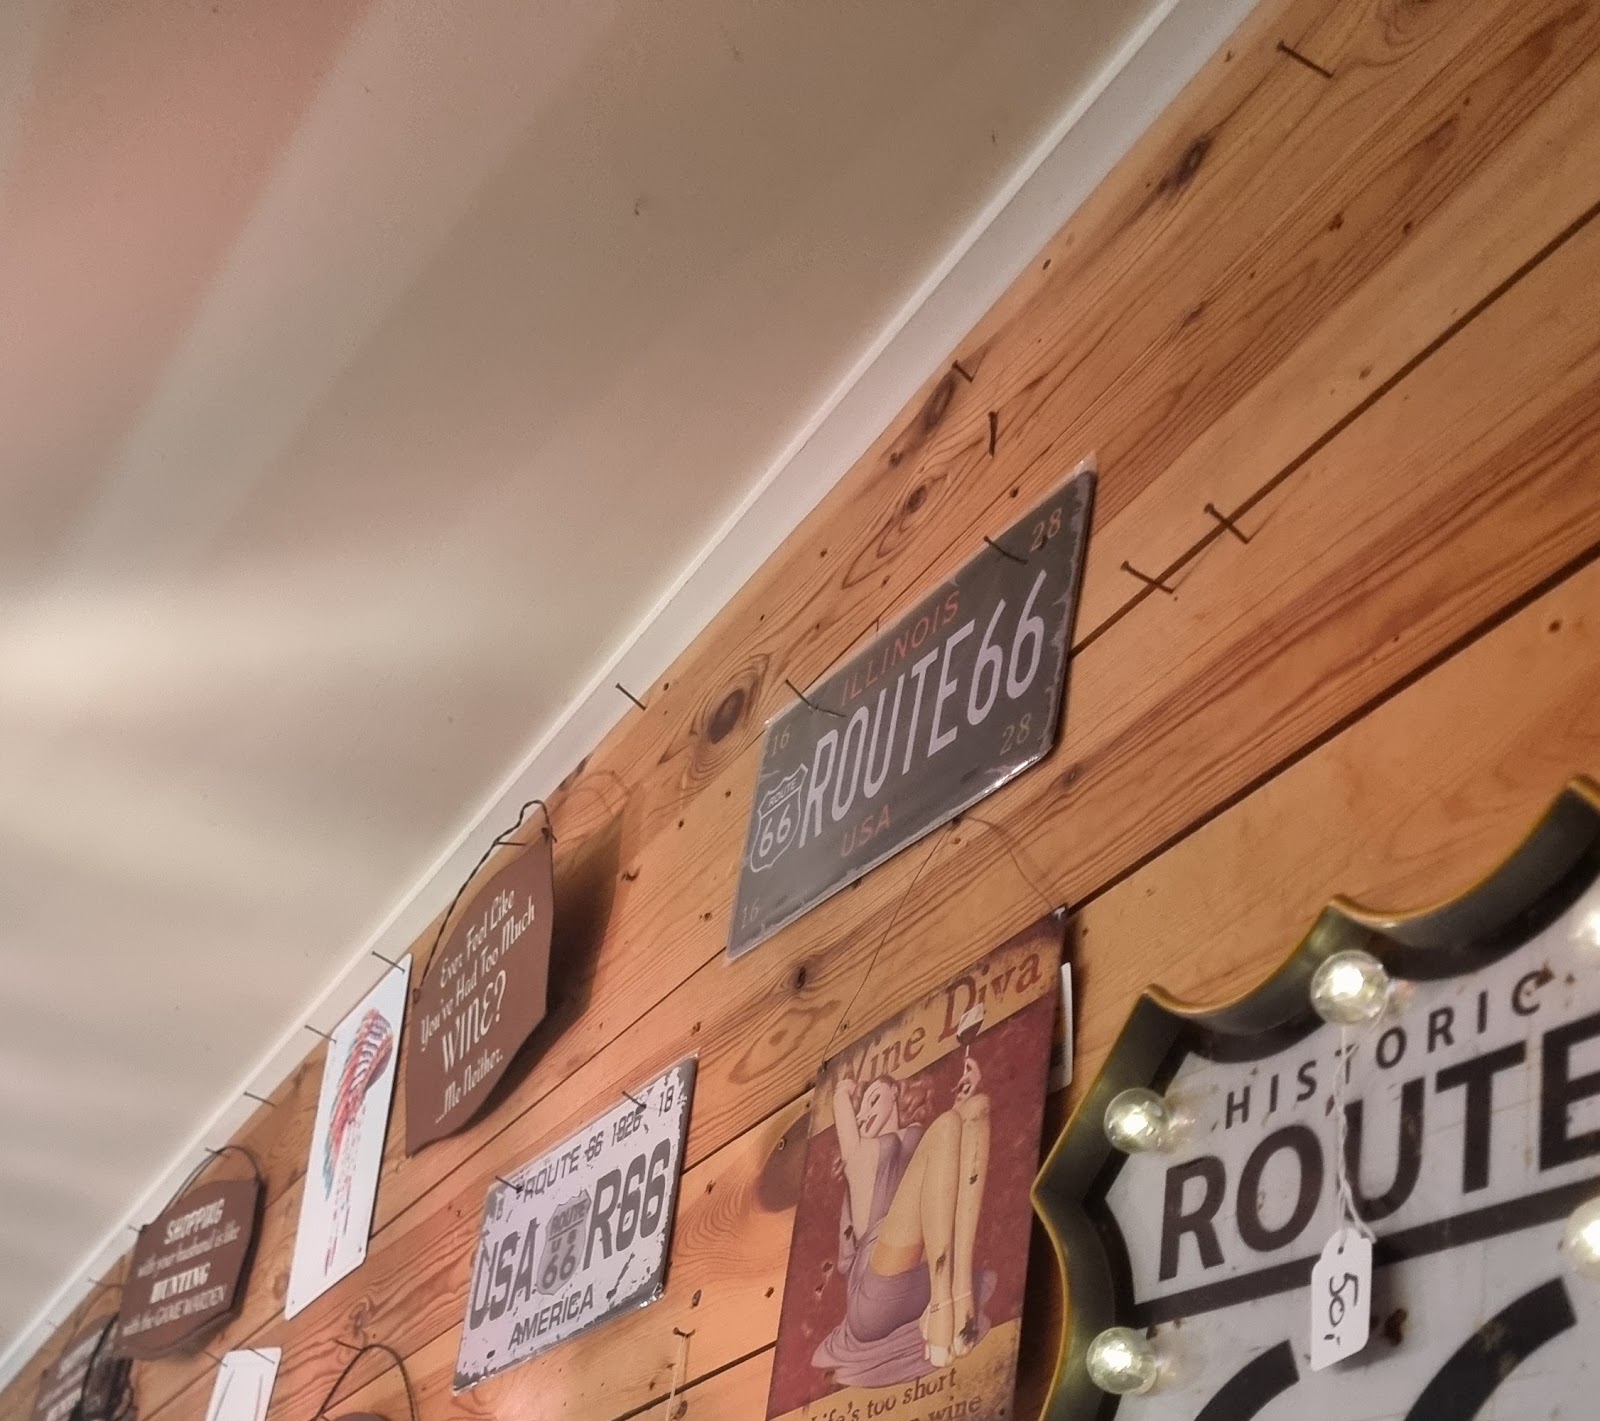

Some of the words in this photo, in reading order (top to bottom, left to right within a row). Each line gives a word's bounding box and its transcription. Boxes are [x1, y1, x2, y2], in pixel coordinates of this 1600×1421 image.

[1031, 507, 1063, 552] 28
[841, 591, 960, 706] ILLINOIS
[1000, 713, 1032, 756] 28
[759, 804, 791, 857] 66
[839, 805, 892, 857] USA
[456, 962, 479, 1006] Had
[480, 945, 499, 977] Too
[501, 895, 536, 956] Much
[466, 912, 488, 958] Feel
[489, 888, 515, 930] Like
[938, 951, 1043, 1041] Diva
[1224, 969, 1552, 1129] HISTORIC
[1158, 1011, 1600, 1282] ROUTE
[582, 1137, 671, 1271] R66
[469, 1216, 541, 1331] USA
[541, 1243, 577, 1290] 66
[508, 1283, 594, 1350] AMERICA
[867, 1395, 897, 1419] too
[902, 1367, 957, 1406] short
